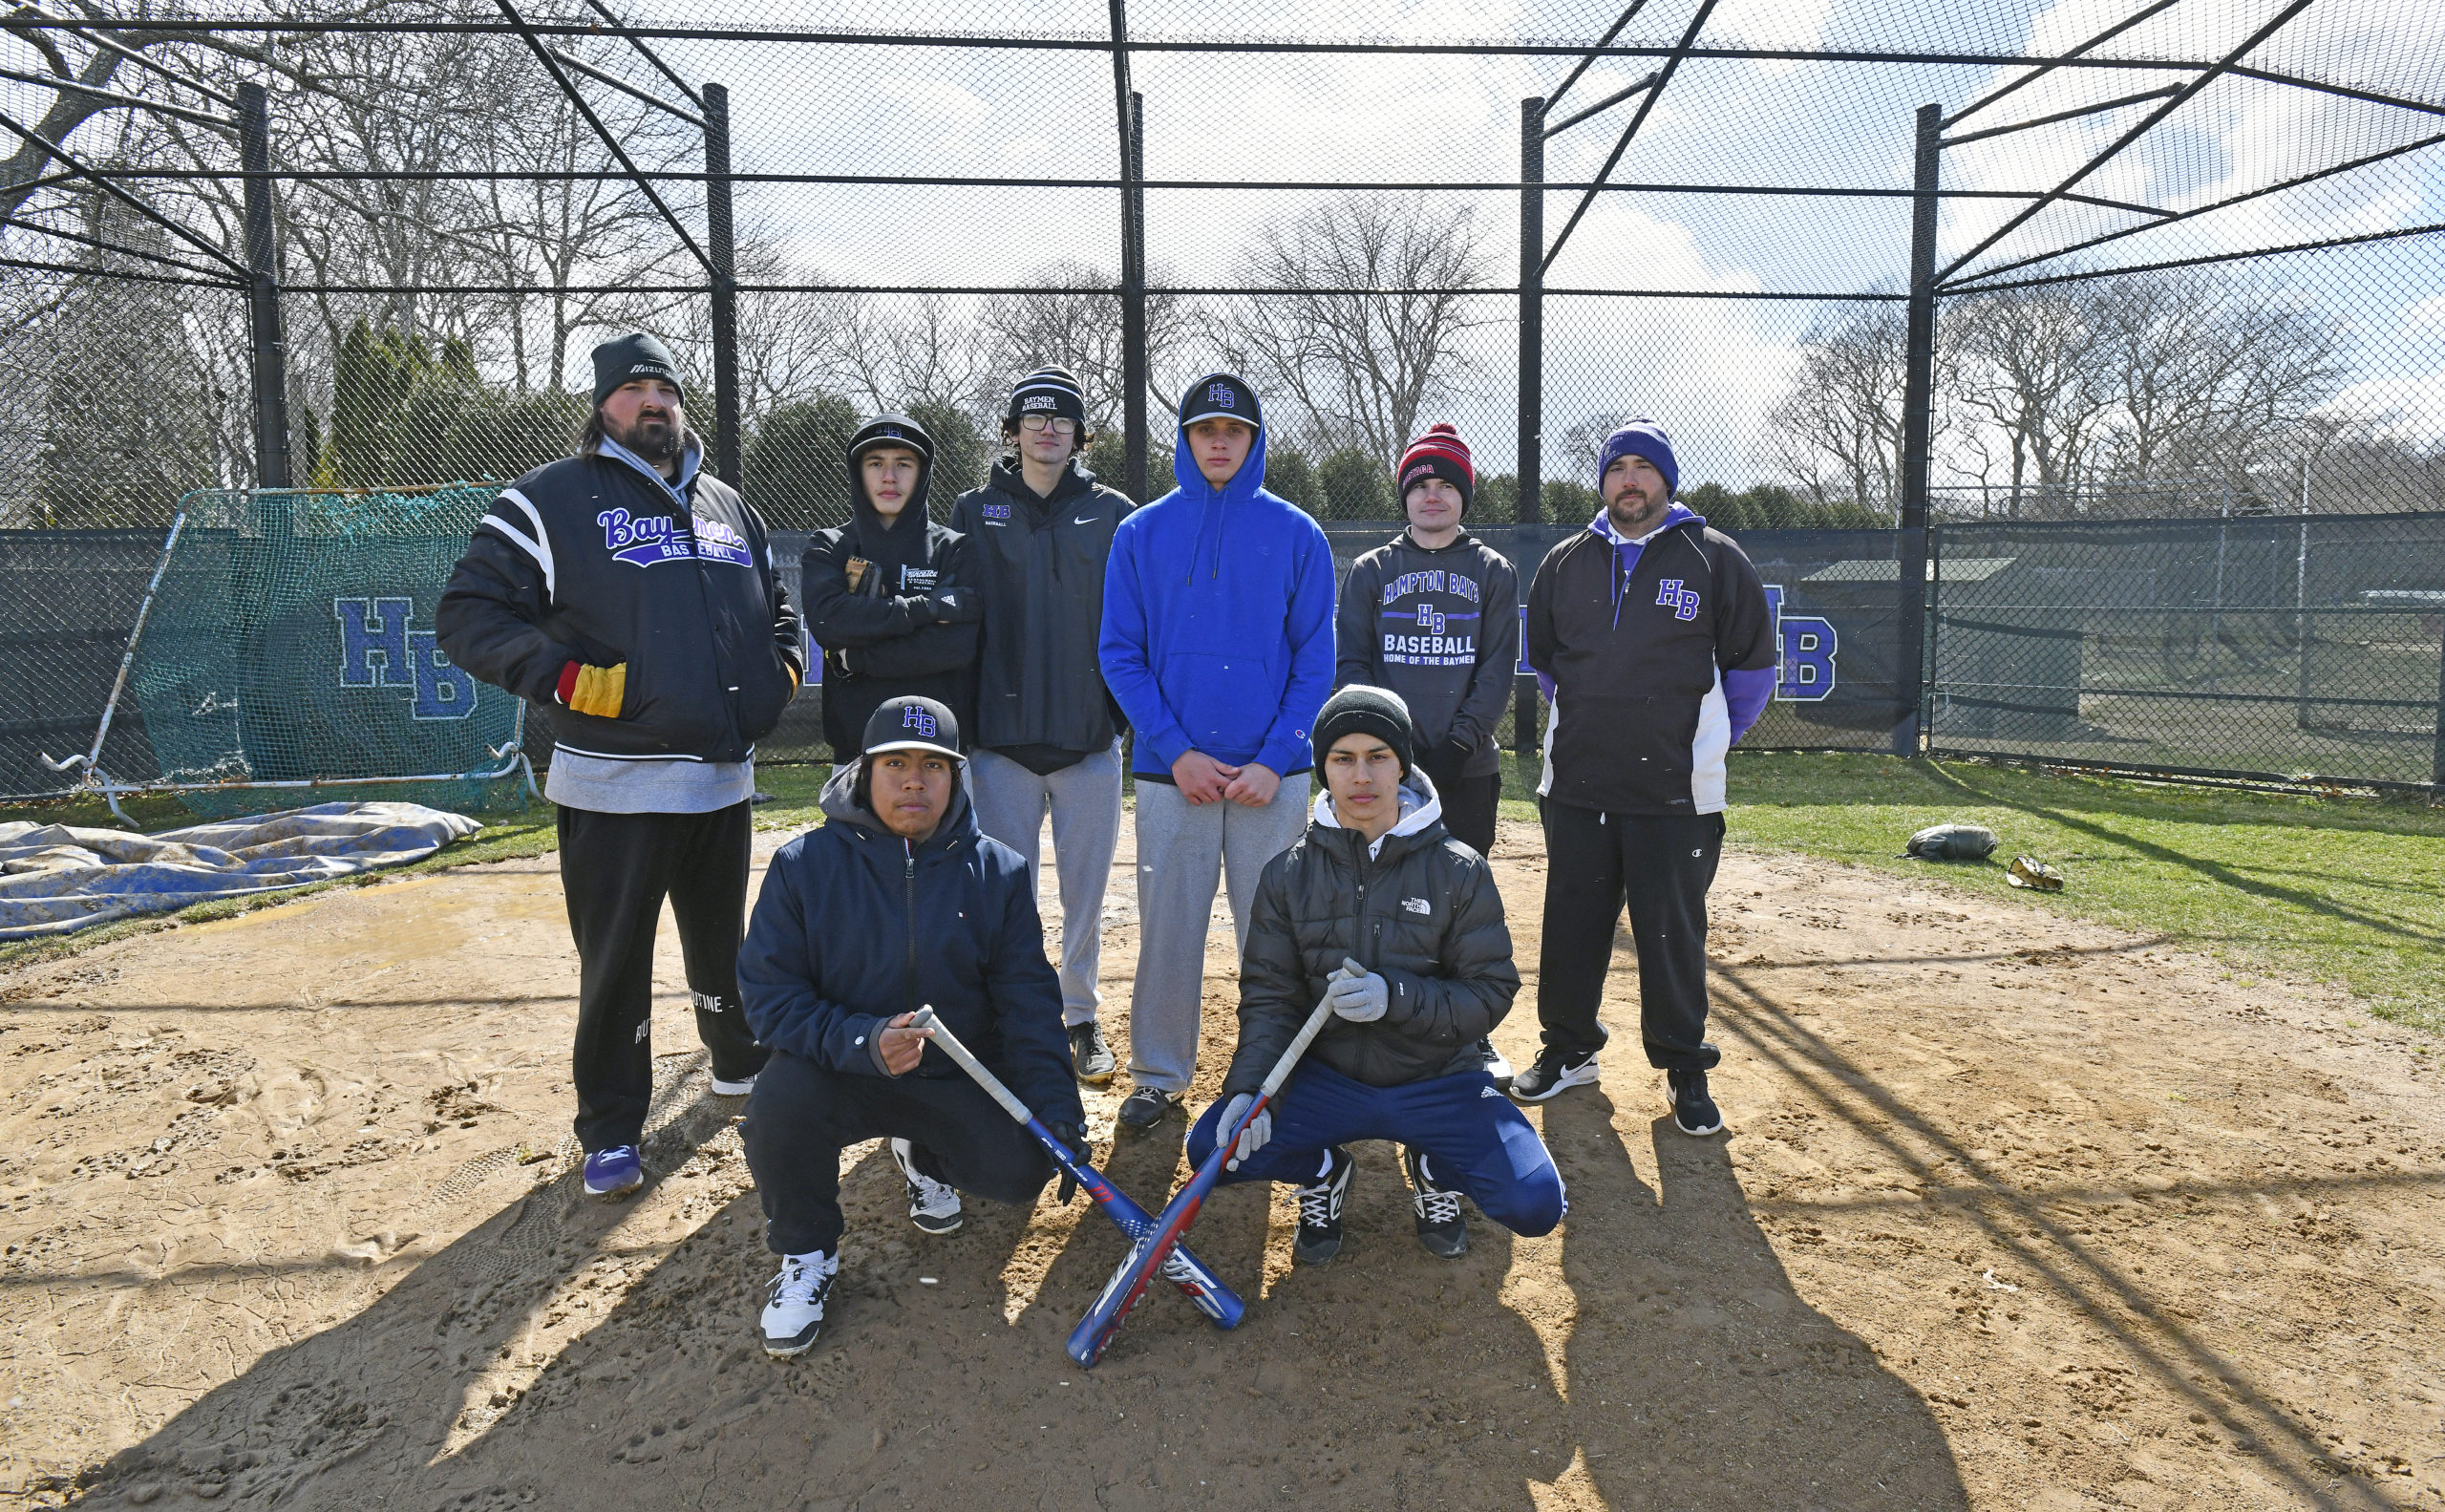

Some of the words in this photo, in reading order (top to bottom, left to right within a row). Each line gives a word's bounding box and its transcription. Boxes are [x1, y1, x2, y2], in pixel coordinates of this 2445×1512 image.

[1022, 402, 1057, 412] BASEBALL
[1024, 395, 1054, 405] BAYMEN
[1207, 383, 1235, 408] HB
[982, 503, 1011, 519] HB
[661, 543, 735, 561] BASEBALL
[1383, 570, 1445, 606] HAMPTON
[1449, 573, 1479, 604] BAYS
[1656, 579, 1700, 621] HB
[1417, 604, 1446, 635] HB
[1384, 634, 1476, 654] BASEBALL
[1762, 585, 1838, 701] B
[334, 597, 478, 720] HB
[1383, 653, 1406, 663] HOME
[1409, 656, 1420, 665] OF
[1423, 656, 1440, 666] THE
[1443, 655, 1476, 666] BAYMEN
[903, 706, 936, 737] HB
